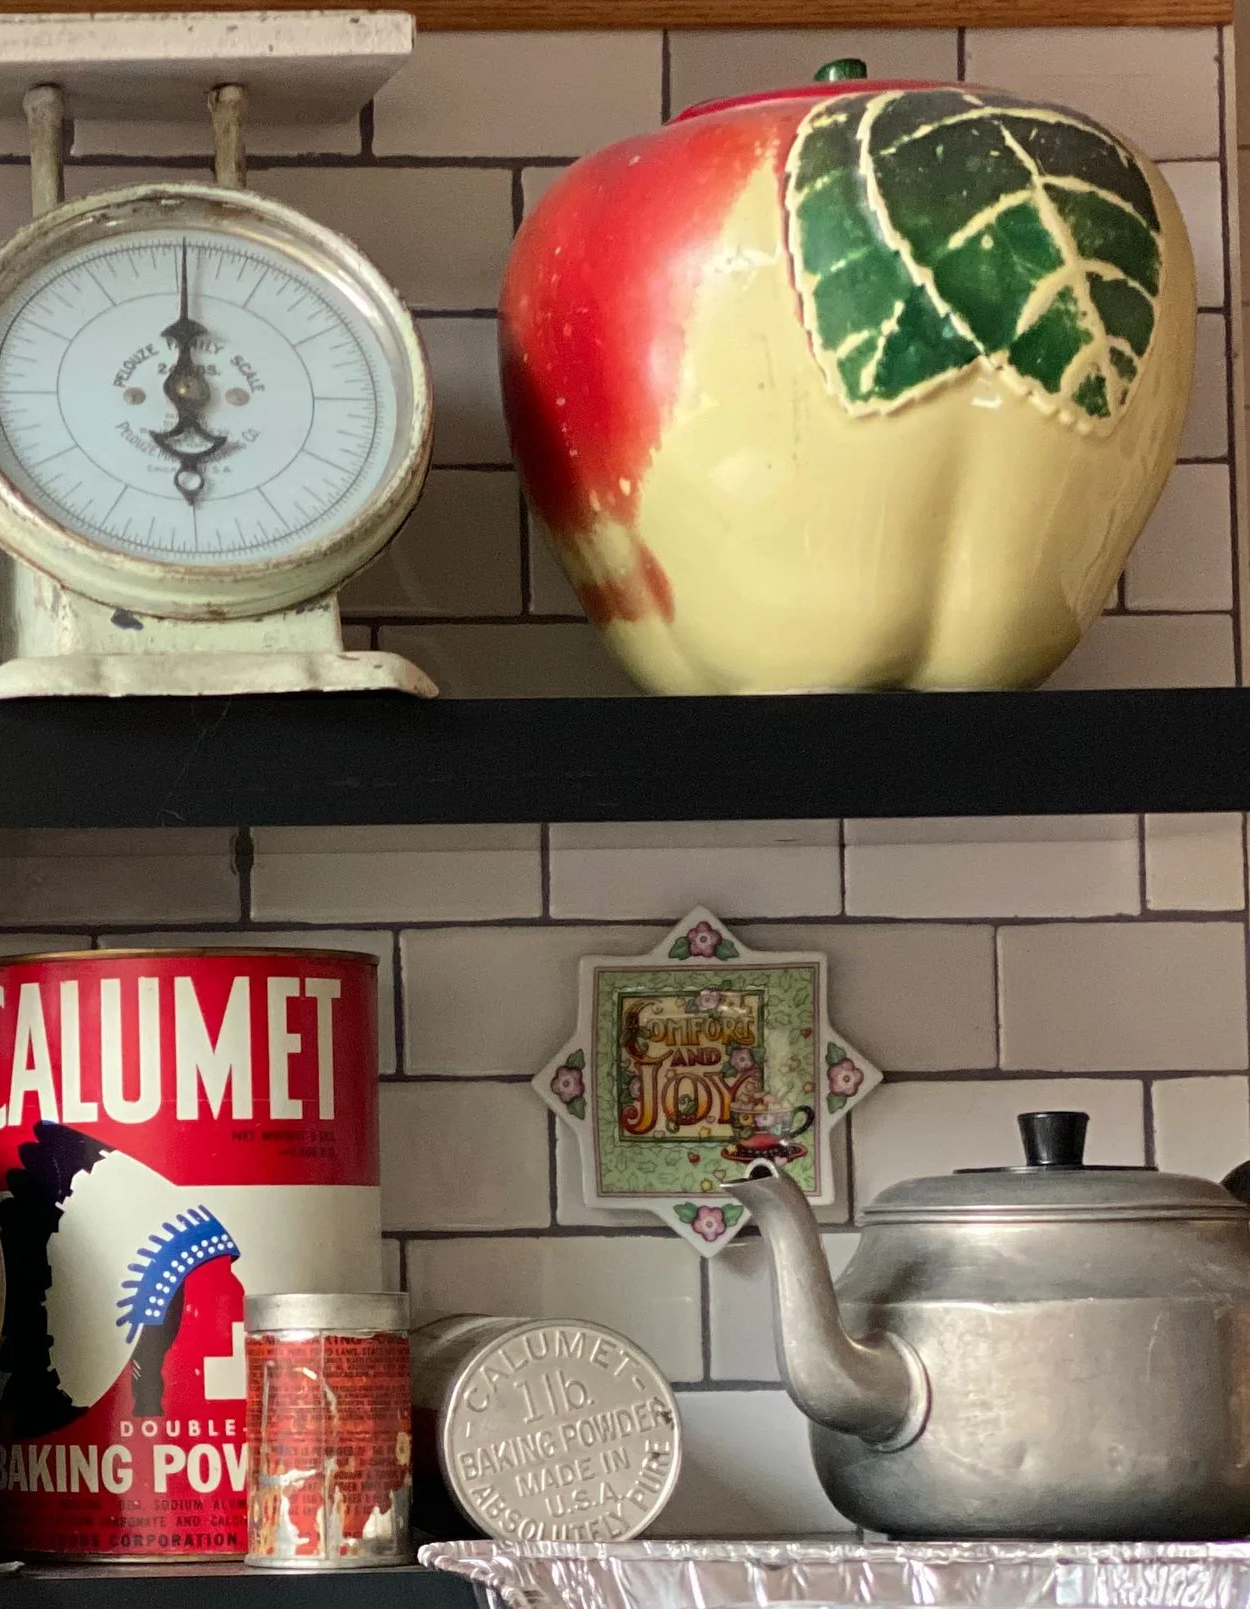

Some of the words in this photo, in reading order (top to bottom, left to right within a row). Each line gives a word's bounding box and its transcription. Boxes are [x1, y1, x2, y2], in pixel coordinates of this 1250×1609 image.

[113, 343, 159, 388] PELOUZE
[230, 355, 265, 393] SCALE
[670, 1047, 721, 1067] AND
[620, 1060, 760, 1135] JOY
[463, 1330, 641, 1413] CALUMET
[457, 1429, 555, 1482] BAKING
[559, 1396, 675, 1453] POWDER
[515, 1457, 596, 1498] MADE
[600, 1446, 631, 1475] IN
[545, 1480, 627, 1518] U.S.A.
[625, 1439, 671, 1512] PURE
[469, 1484, 631, 1541] ABSOLUTELY
[110, 1533, 238, 1548] CORPORATION
